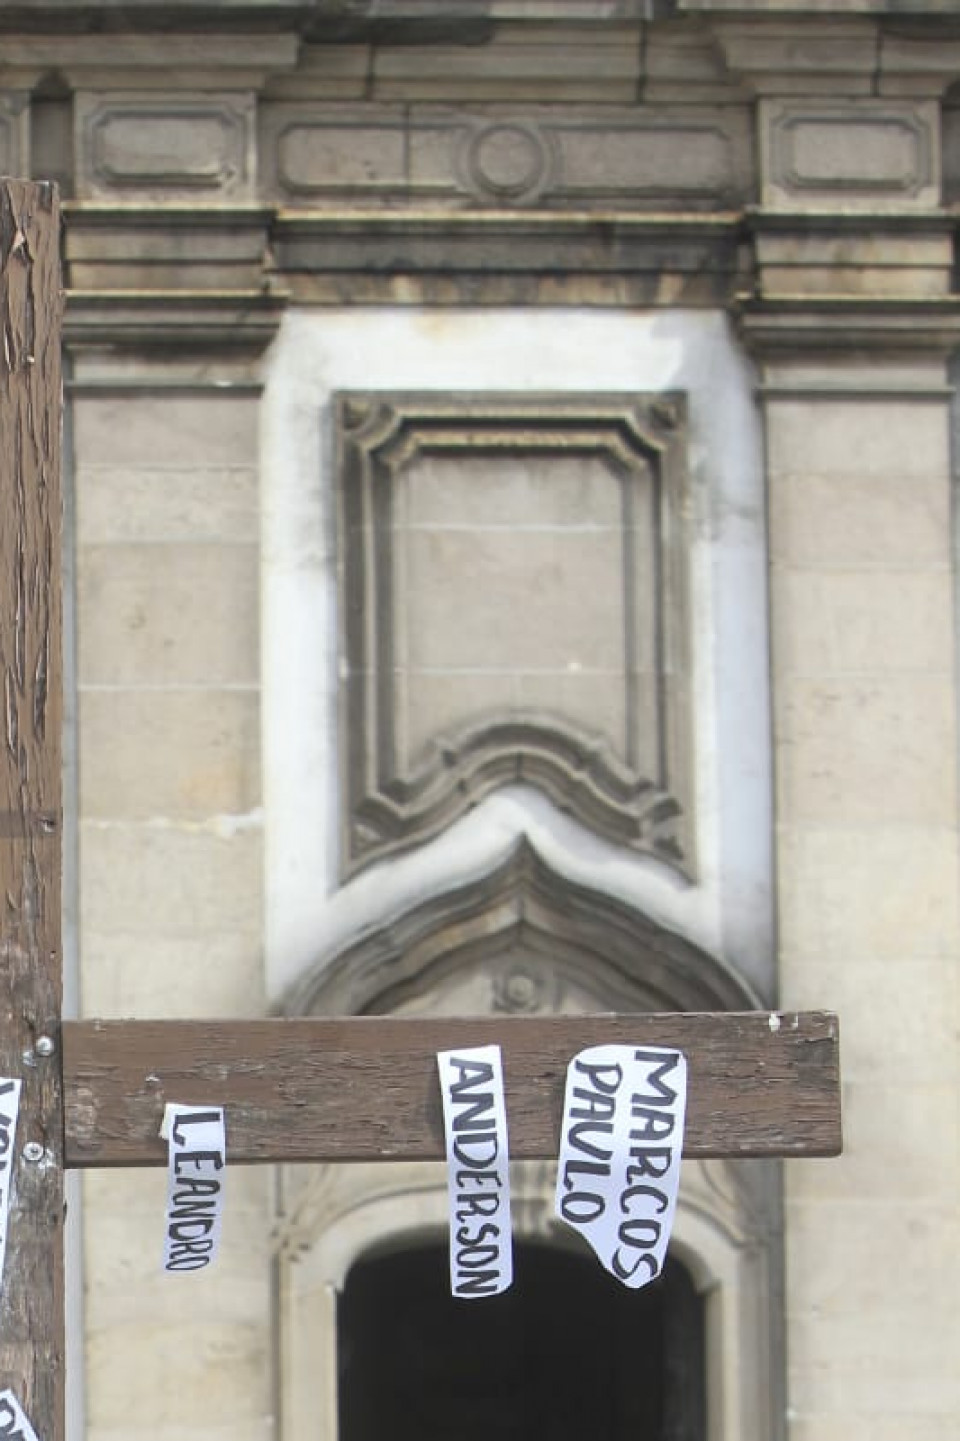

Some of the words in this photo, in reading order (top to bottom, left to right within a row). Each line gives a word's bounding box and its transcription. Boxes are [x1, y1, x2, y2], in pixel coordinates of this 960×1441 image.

[166, 1111, 224, 1271] LEANDRO
[449, 1056, 503, 1294] ANDERSON
[560, 1059, 624, 1224] PAULO
[611, 1049, 680, 1280] MARCOS
